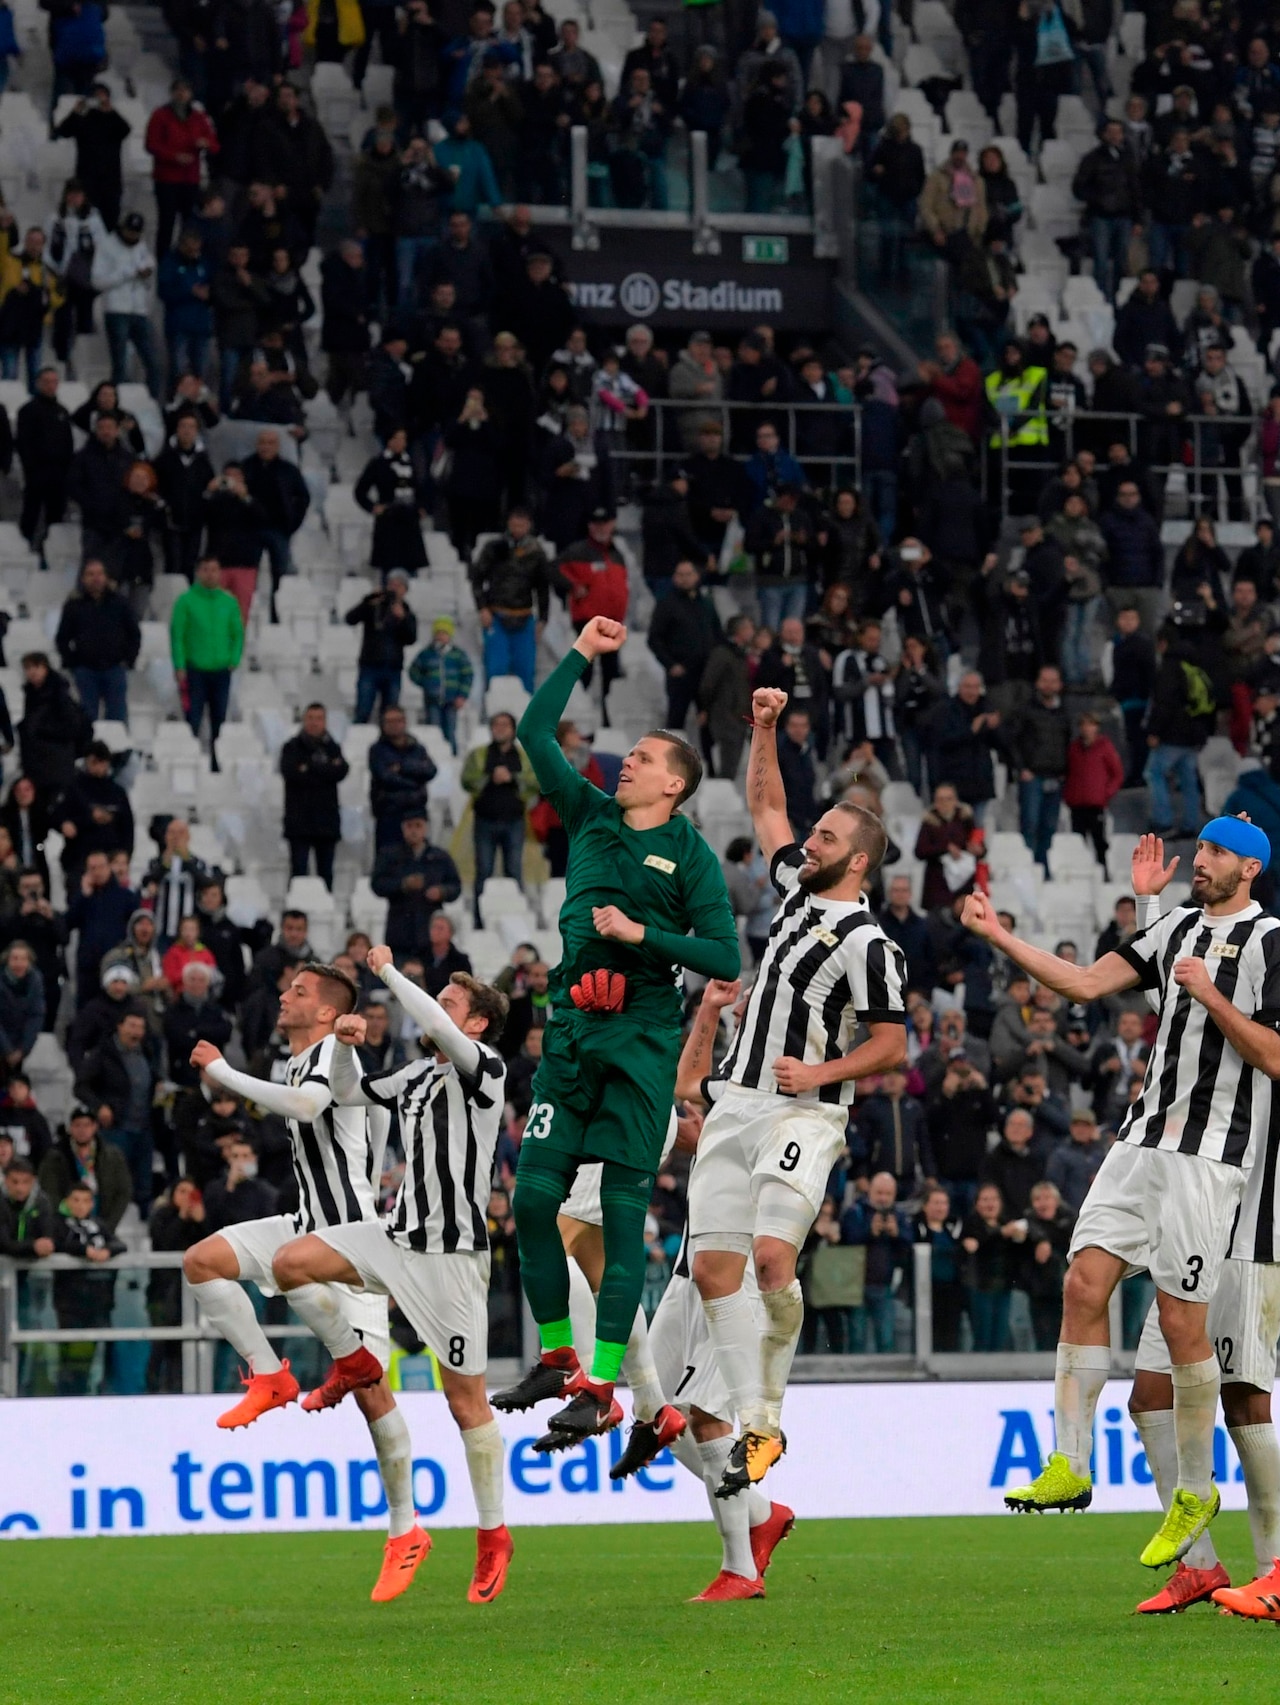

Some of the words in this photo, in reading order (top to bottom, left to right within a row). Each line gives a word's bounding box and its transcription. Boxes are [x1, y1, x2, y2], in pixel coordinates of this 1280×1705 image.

[663, 279, 783, 312] Stadium
[522, 1103, 555, 1139] 23
[779, 1141, 801, 1172] 9
[1181, 1255, 1204, 1292] 3
[449, 1336, 465, 1367] 8
[71, 1464, 144, 1529] in
[172, 1451, 446, 1523] tempo
[503, 1423, 675, 1494] eale
